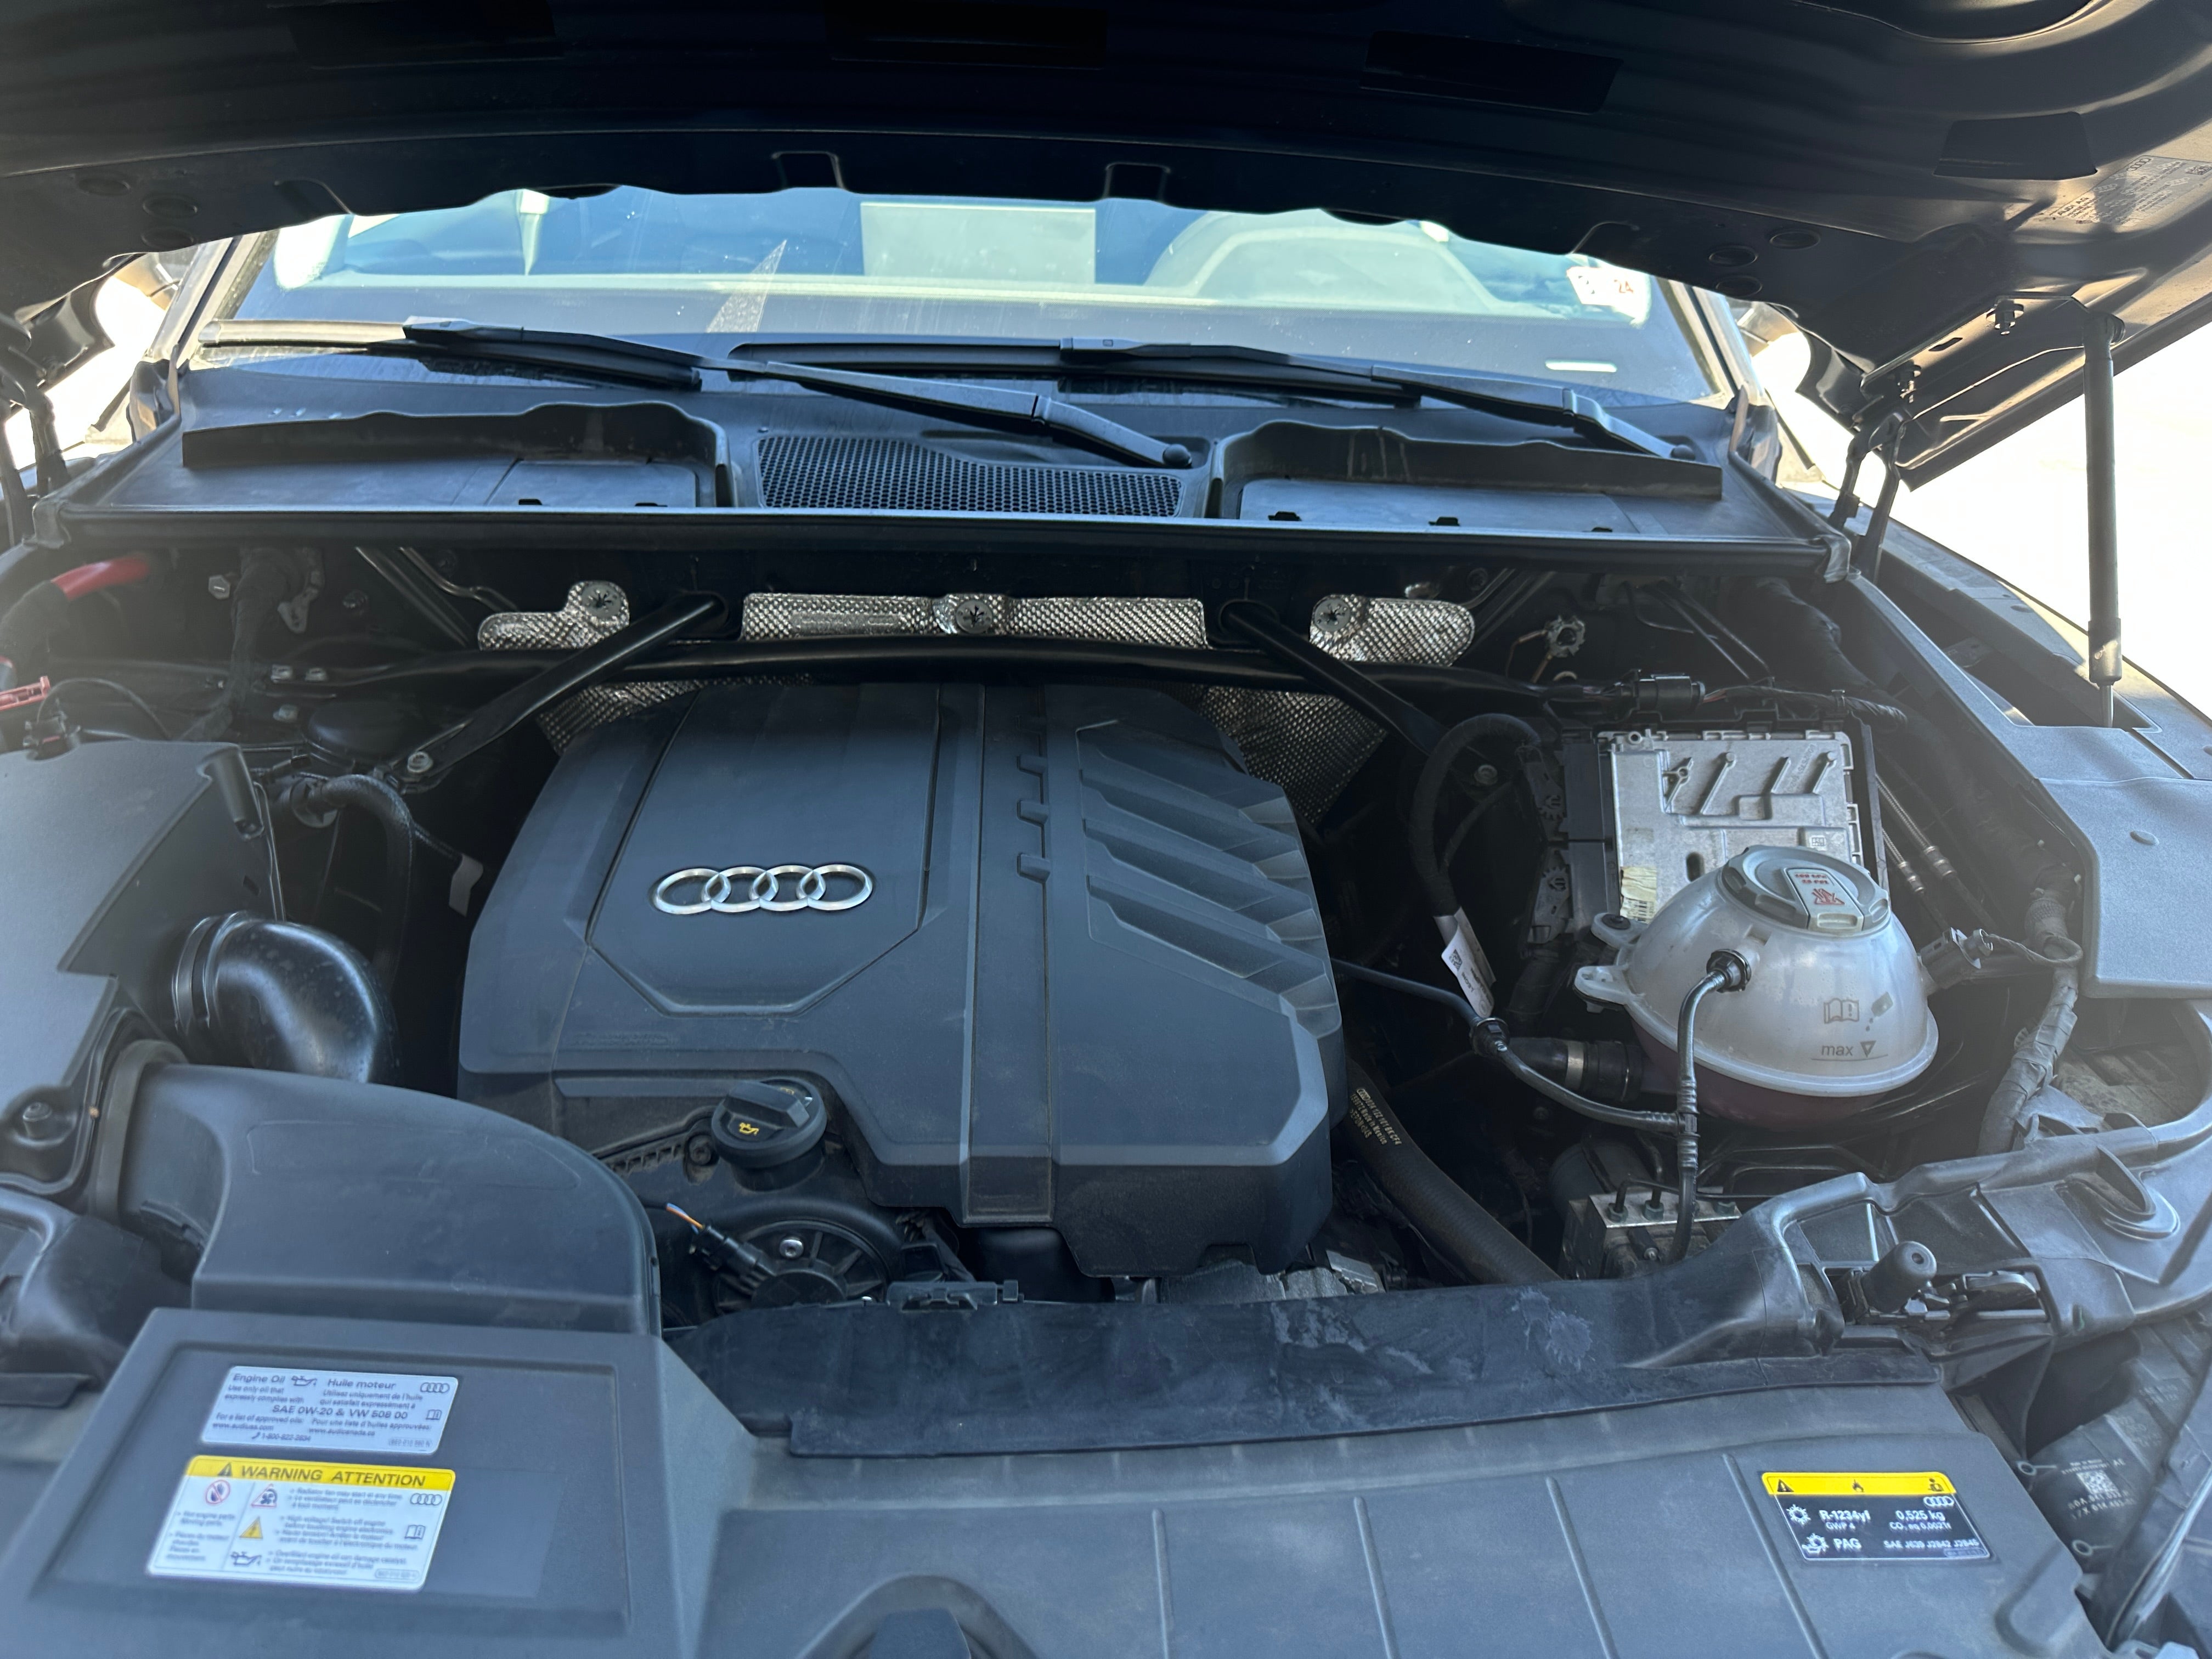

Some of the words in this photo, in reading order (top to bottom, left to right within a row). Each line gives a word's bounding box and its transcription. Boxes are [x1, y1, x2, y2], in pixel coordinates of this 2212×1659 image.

[2058, 205, 2075, 215] AUDI
[1821, 1045, 1853, 1057] max
[233, 1373, 268, 1384] Engine
[271, 1374, 286, 1383] Oil
[328, 1378, 354, 1387] Huile
[357, 1380, 396, 1389] moteur
[242, 1385, 259, 1393] only
[349, 1391, 391, 1400] uniquement
[273, 1404, 295, 1413] SAE
[298, 1406, 333, 1415] 0W-20
[336, 1408, 346, 1416] &
[348, 1409, 369, 1418] VW
[371, 1410, 392, 1418] 508
[255, 1415, 289, 1424] approved
[240, 1465, 323, 1481] WARNING
[331, 1470, 426, 1487] ATTENTION
[1819, 1510, 1872, 1520] R-1234yf
[1895, 1510, 1929, 1520] 0,525
[1929, 1510, 1946, 1520] kg
[1833, 1538, 1863, 1549] PAG
